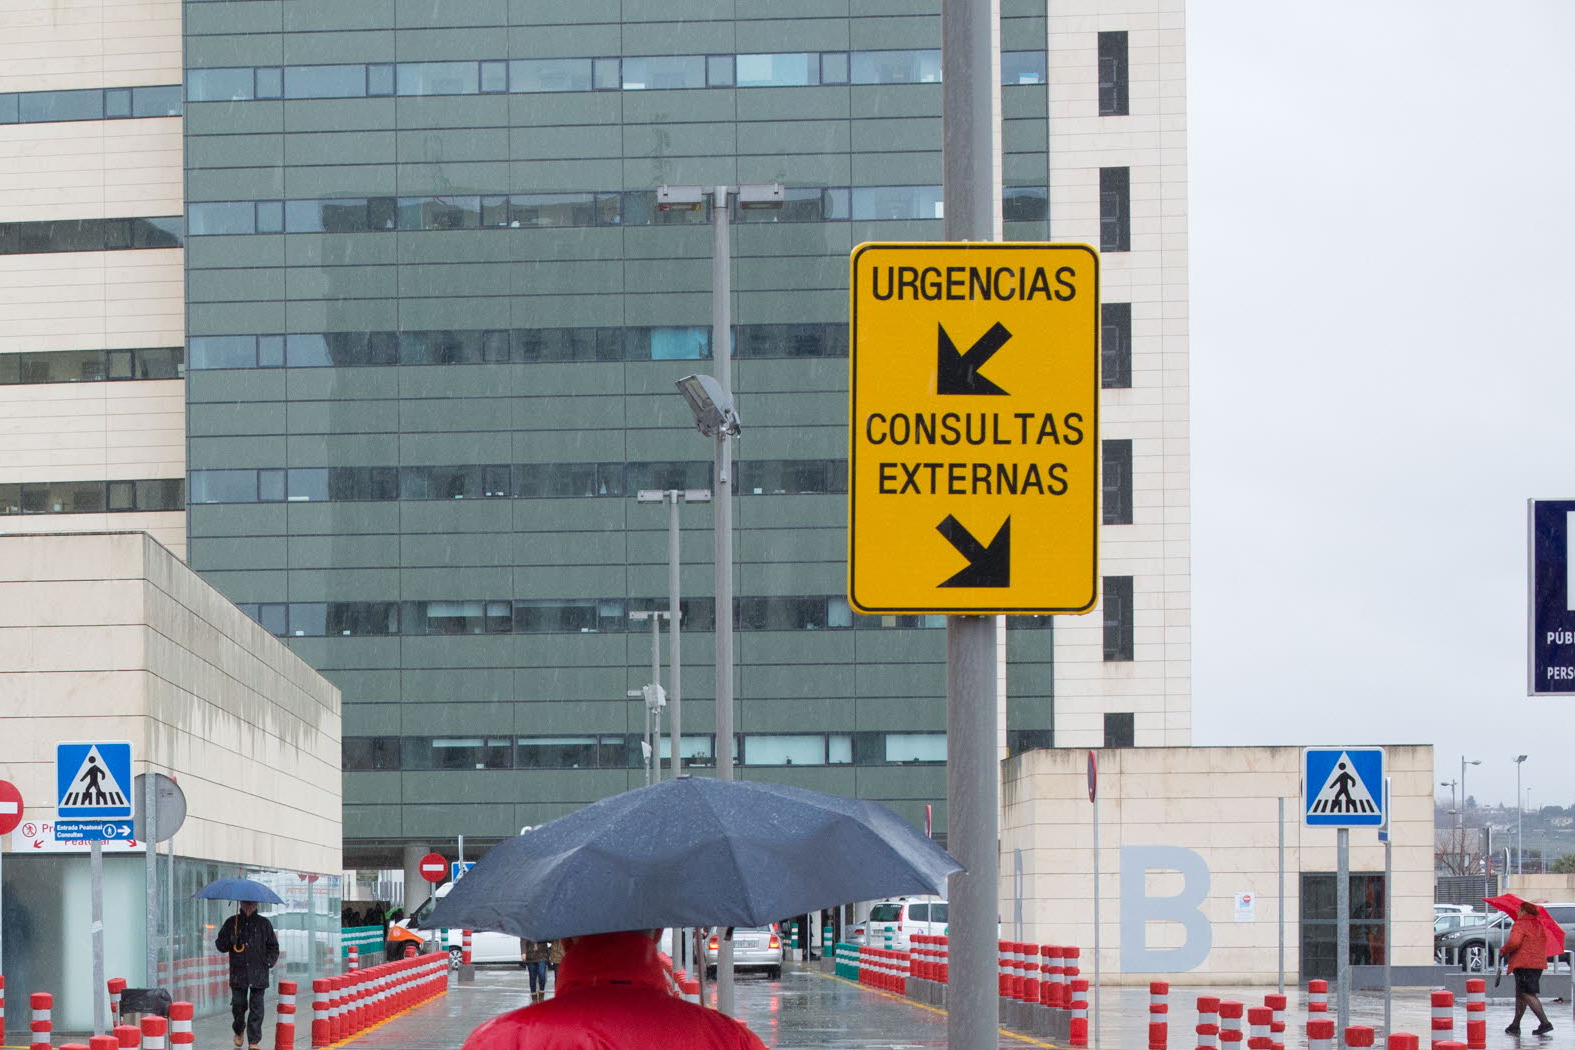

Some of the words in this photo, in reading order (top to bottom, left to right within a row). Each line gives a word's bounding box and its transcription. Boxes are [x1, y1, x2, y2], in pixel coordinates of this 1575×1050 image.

[872, 266, 1077, 301] URGENCIAS
[866, 412, 1084, 446] CONSULTAS
[878, 462, 1068, 496] EXTERNAS
[42, 824, 55, 833] Pr
[1119, 845, 1212, 973] B
